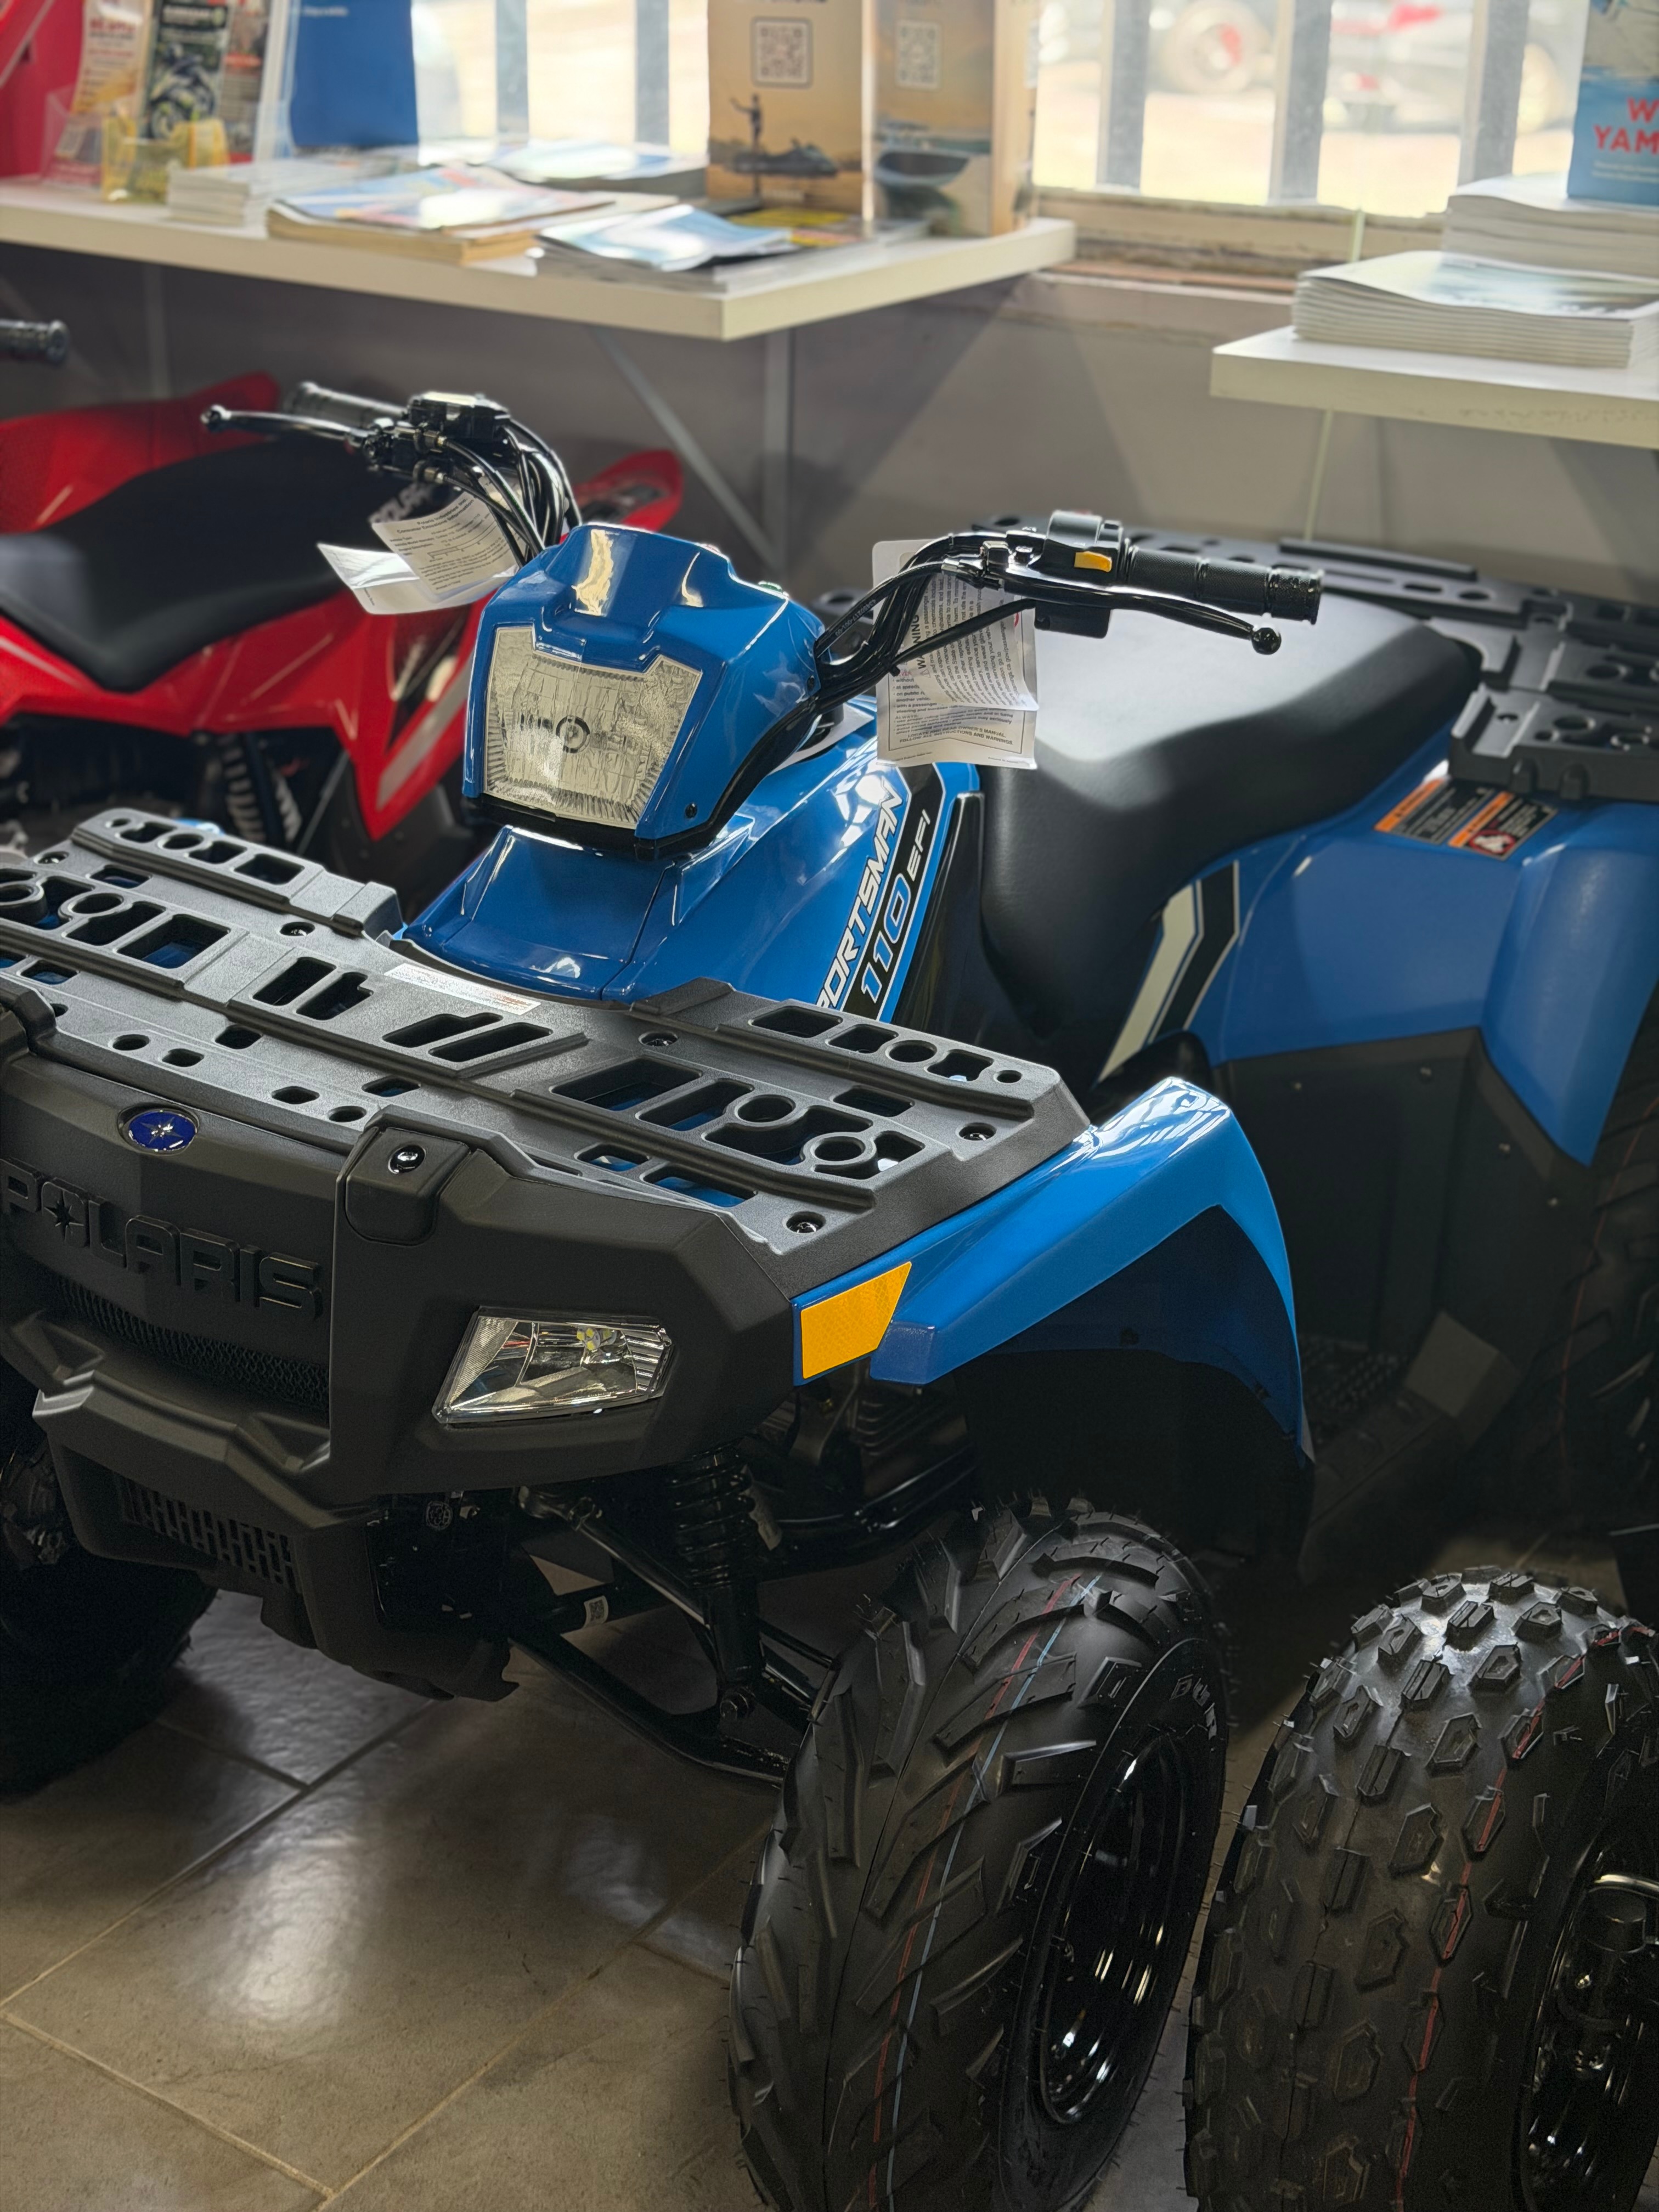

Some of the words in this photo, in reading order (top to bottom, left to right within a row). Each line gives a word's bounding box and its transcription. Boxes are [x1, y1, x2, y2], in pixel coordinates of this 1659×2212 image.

[816, 776, 904, 1011] PORTSMAN
[861, 873, 911, 1005] 110
[907, 809, 931, 882] EFI
[0, 1157, 324, 1320] POLARIS
